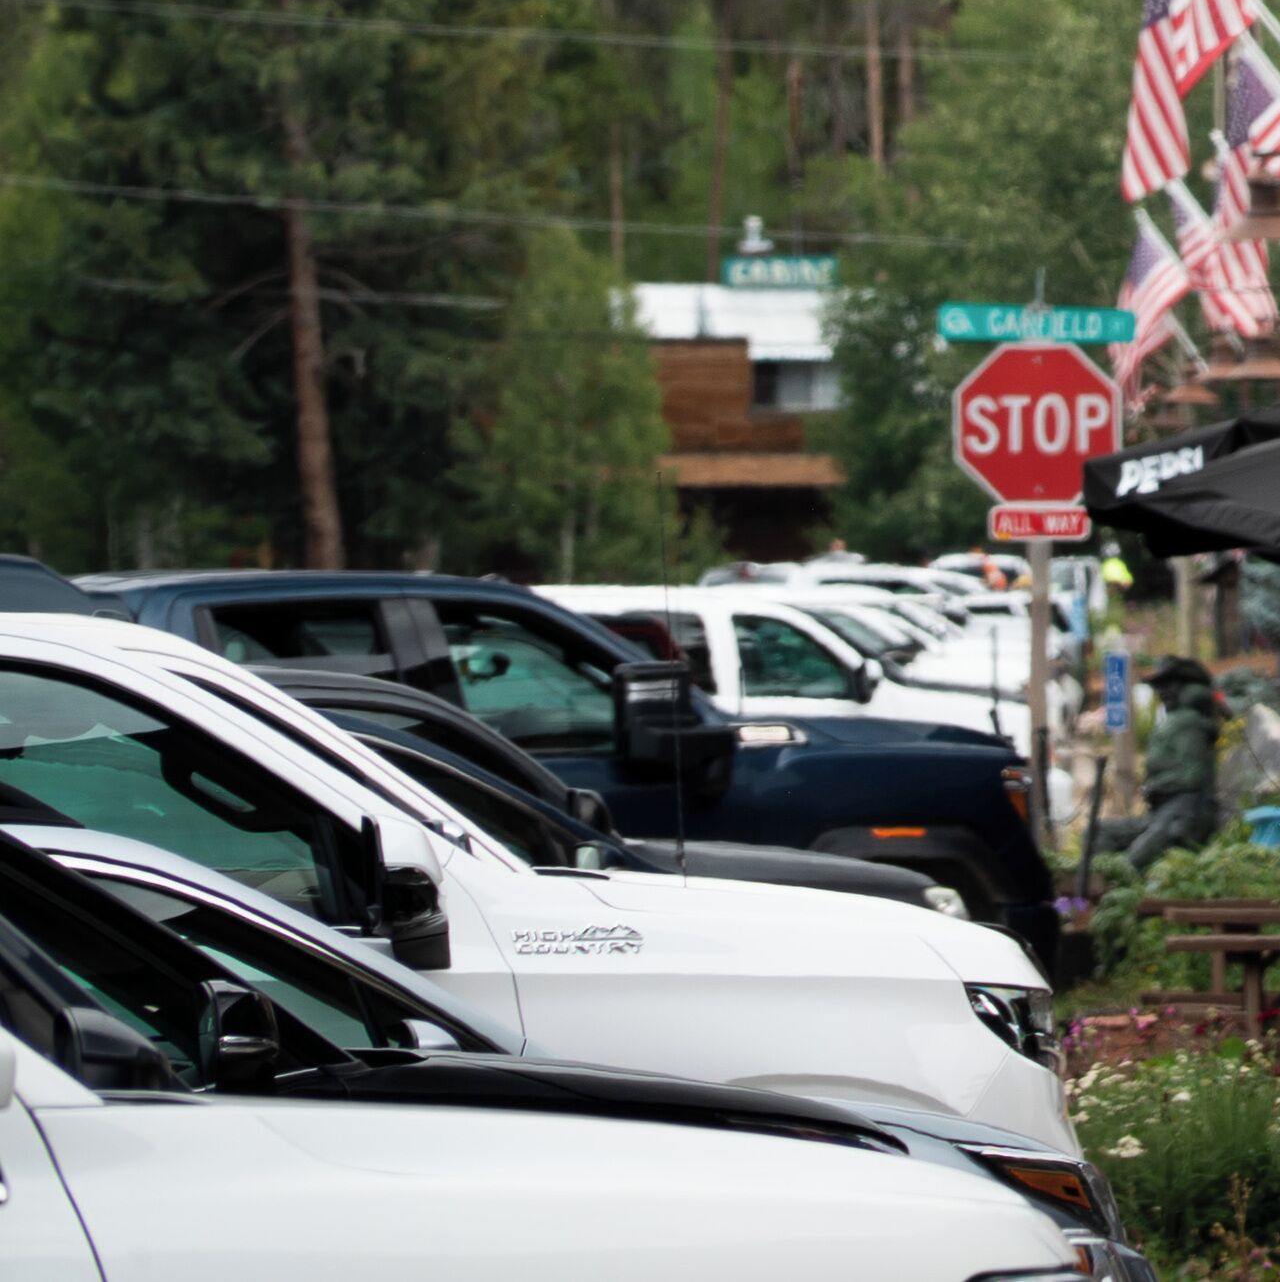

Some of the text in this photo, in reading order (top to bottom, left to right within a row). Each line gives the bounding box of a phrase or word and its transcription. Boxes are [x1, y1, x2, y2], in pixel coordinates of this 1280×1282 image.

[963, 393, 1111, 456] STOP
[1046, 514, 1081, 534] WAY
[513, 929, 645, 955] HIGH COUNTRY
